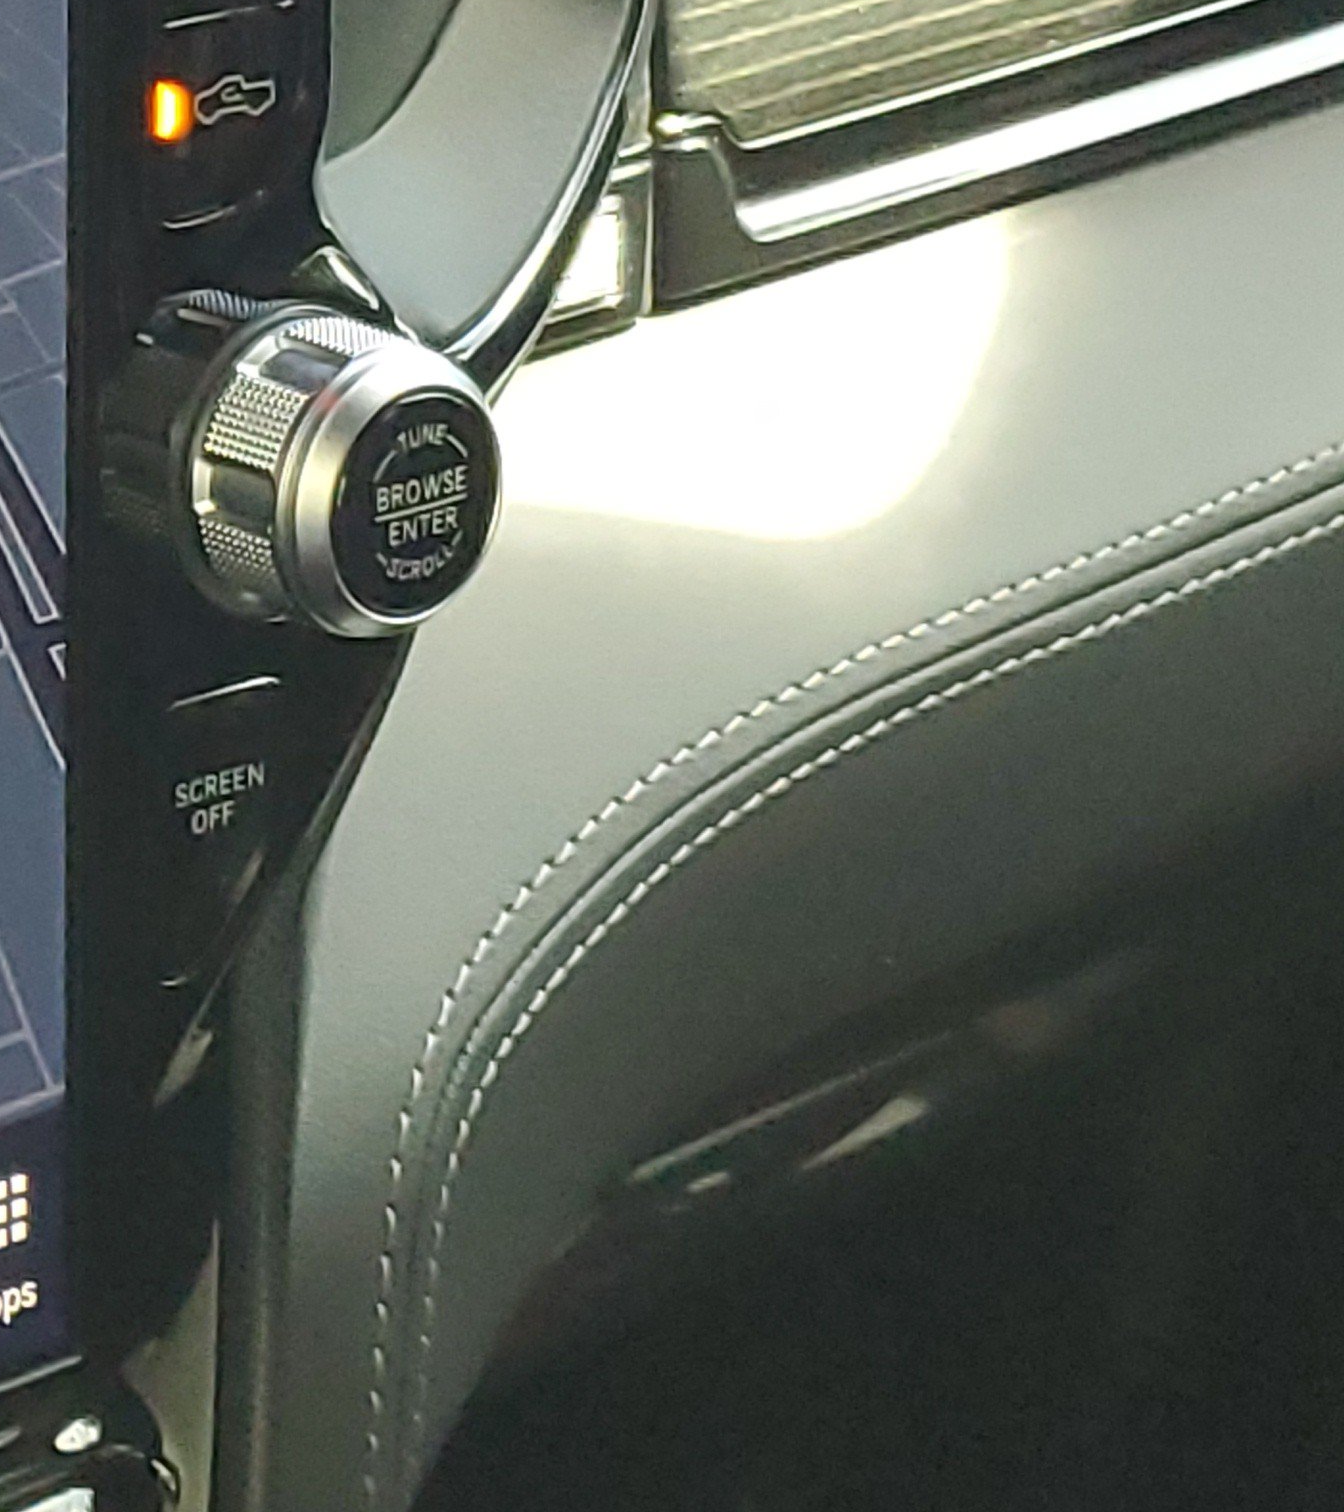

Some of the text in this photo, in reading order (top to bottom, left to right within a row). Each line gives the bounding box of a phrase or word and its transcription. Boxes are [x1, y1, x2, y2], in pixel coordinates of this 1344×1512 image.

[397, 423, 449, 452] TUNE
[376, 464, 469, 513] BROWSE
[388, 506, 458, 547] ENTER
[386, 544, 454, 580] SCROLL
[174, 762, 265, 808] SCREEN
[191, 800, 236, 835] OFF
